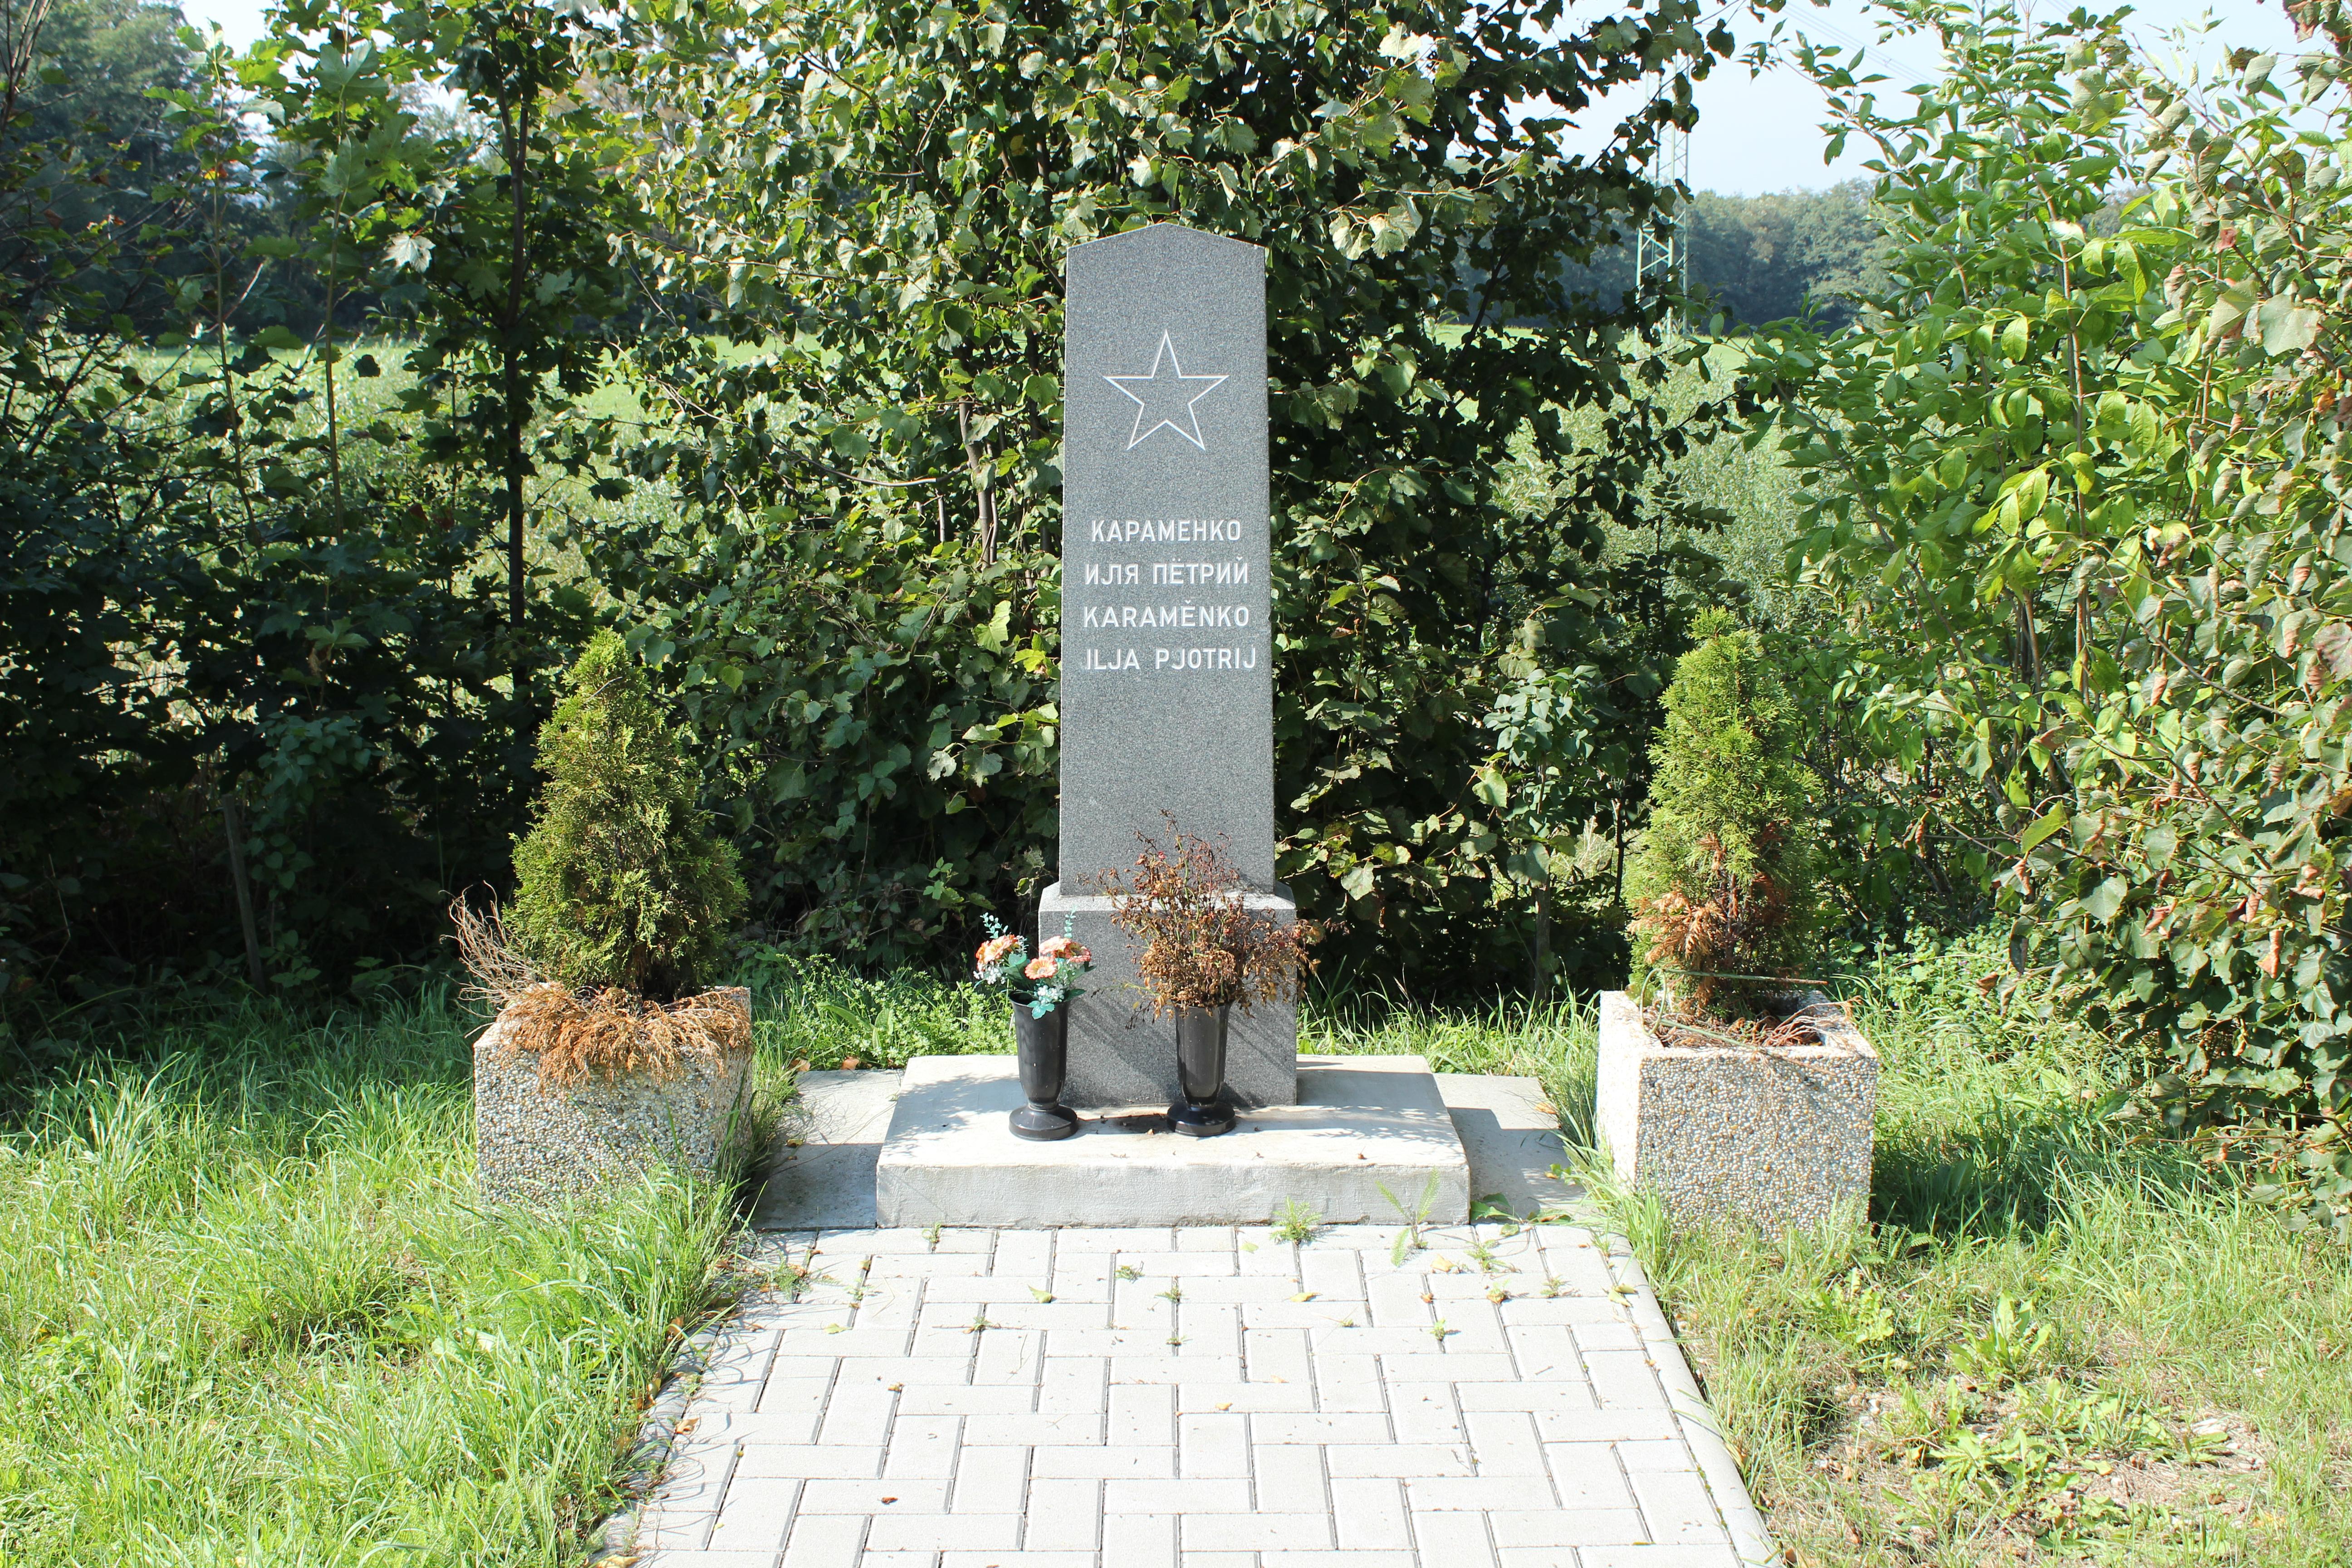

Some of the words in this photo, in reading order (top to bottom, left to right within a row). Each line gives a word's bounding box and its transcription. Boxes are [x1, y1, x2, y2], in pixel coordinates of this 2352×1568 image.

[1091, 519, 1241, 542] КАРАМЕНКО
[1084, 563, 1139, 585] ИЛЯ
[1152, 556, 1248, 584] ПЁТРИЙ
[1083, 600, 1250, 627] KARAMĚNKO
[1085, 648, 1140, 670] ILJA
[1155, 647, 1256, 670] PJOTRIJ
